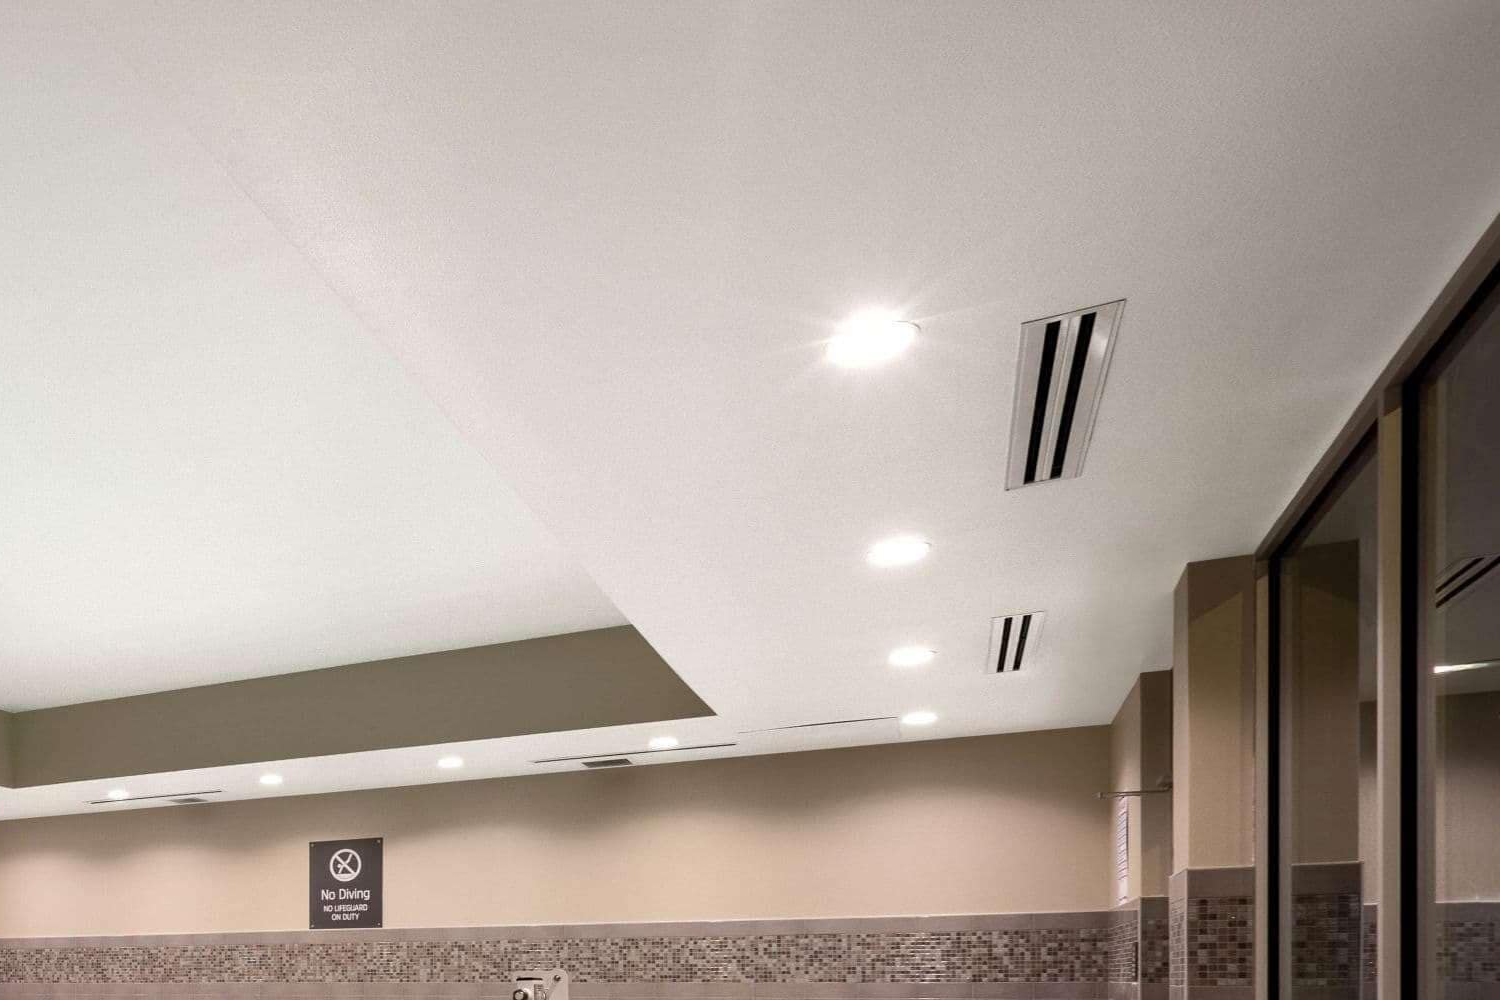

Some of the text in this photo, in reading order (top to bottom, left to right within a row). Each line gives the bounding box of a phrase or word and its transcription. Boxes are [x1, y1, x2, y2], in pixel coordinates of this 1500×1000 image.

[321, 888, 370, 900] No Diving
[334, 904, 368, 912] LIFEGUARD
